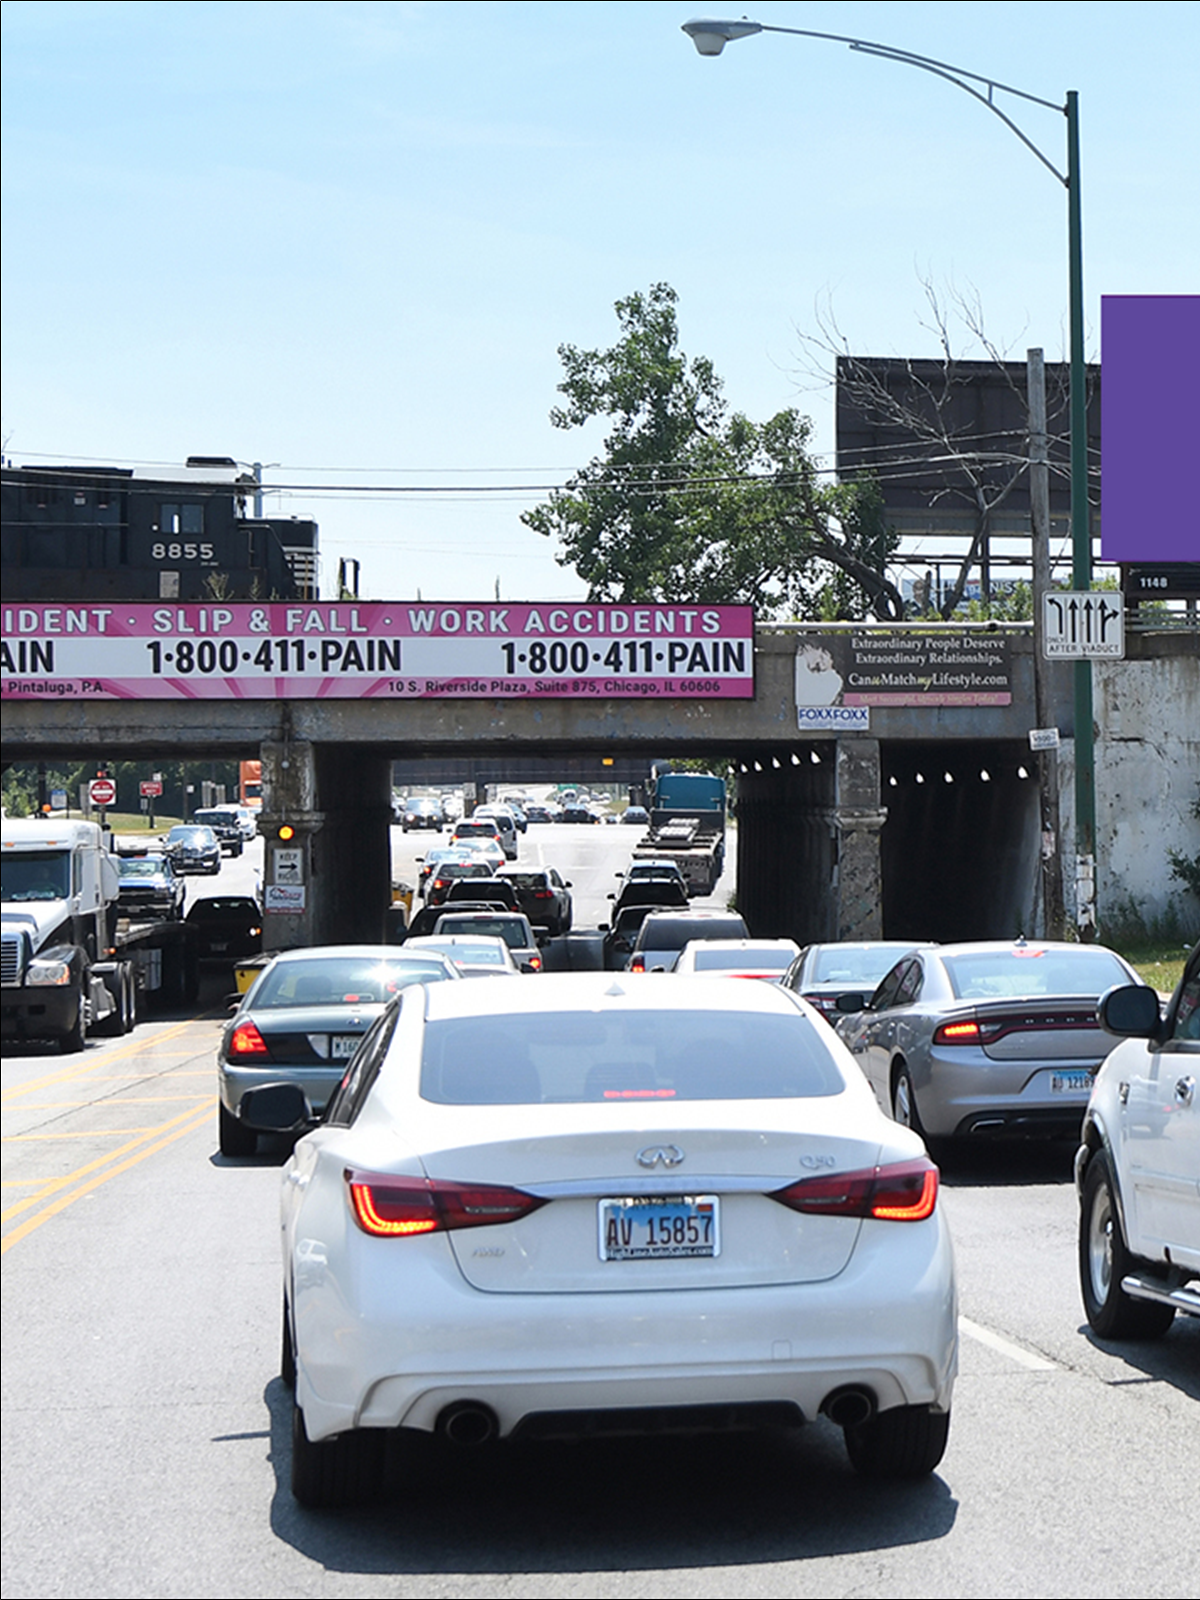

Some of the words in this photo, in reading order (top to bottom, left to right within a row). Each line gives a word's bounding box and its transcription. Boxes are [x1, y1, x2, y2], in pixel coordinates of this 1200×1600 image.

[152, 543, 214, 560] 8855
[5, 609, 112, 633] IDENT
[153, 608, 233, 633] SLIP
[249, 608, 270, 633] &
[286, 608, 368, 633] FALL
[408, 609, 511, 633] WORK
[524, 609, 721, 633] ACCIDENTS
[851, 638, 924, 651] Extraordinary
[925, 638, 960, 651] People
[963, 638, 1005, 649] Deserve
[1049, 644, 1077, 653] AFTER
[1081, 644, 1119, 653] VIADUCT
[855, 653, 926, 667] Extraordinary
[929, 653, 1003, 667] Relationships.
[8, 681, 78, 695] Pintaluga,
[82, 681, 108, 693] P.A.
[389, 681, 404, 693] 10
[408, 681, 422, 693] S.
[426, 681, 487, 693] Riverside
[491, 681, 531, 694] Plaza,
[535, 681, 568, 693] Suite
[572, 681, 600, 694] 875,
[604, 681, 661, 695] Chicago,
[664, 681, 676, 693] IL
[680, 681, 720, 693] 60606
[799, 708, 832, 720] FOXX
[833, 708, 868, 720] FOXX
[607, 1217, 632, 1246] AV
[646, 1215, 712, 1245] 15857
